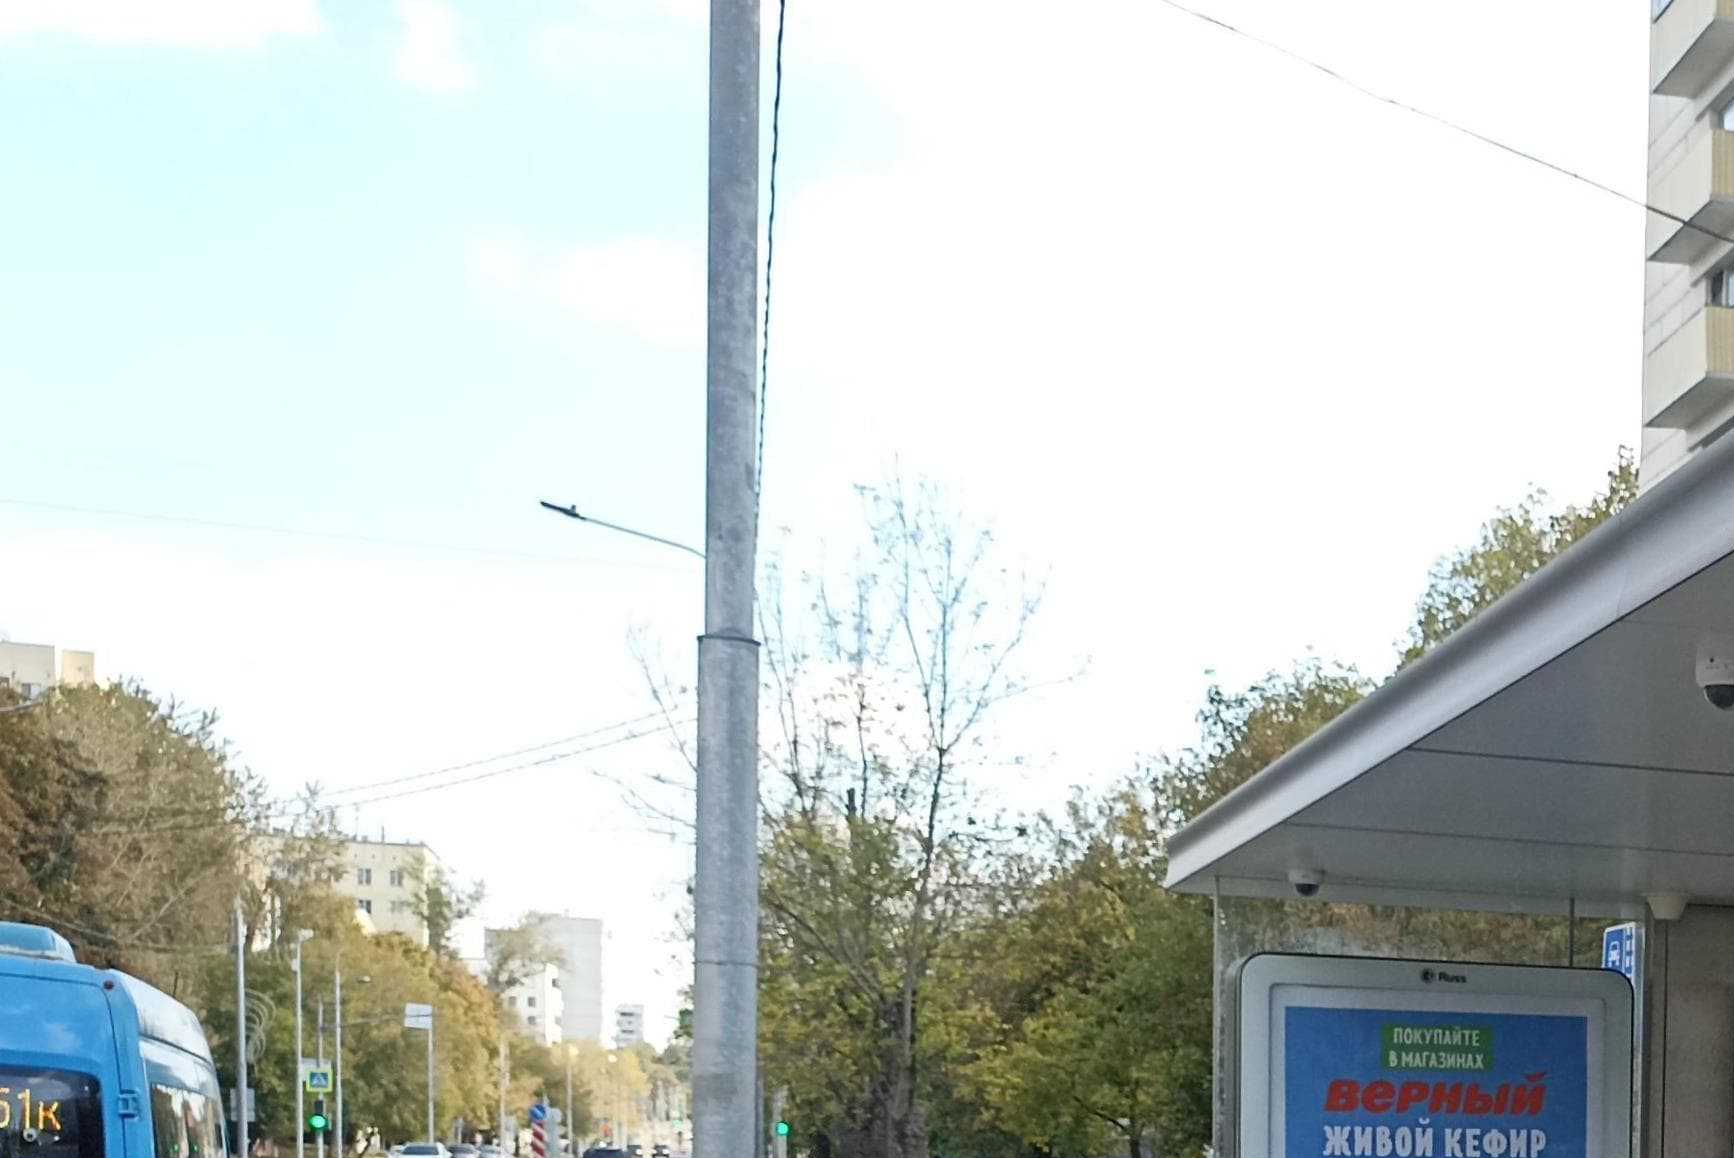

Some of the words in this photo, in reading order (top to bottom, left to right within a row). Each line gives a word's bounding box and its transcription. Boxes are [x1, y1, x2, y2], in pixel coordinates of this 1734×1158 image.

[1393, 1026, 1480, 1046] ПОКУПАЙТЕ
[1388, 1051, 1398, 1067] В
[1401, 1051, 1484, 1069] МАГАЗИНАХ
[1323, 1117, 1434, 1157] ЖИВОЙ
[1444, 1128, 1547, 1158] КЕФИР
